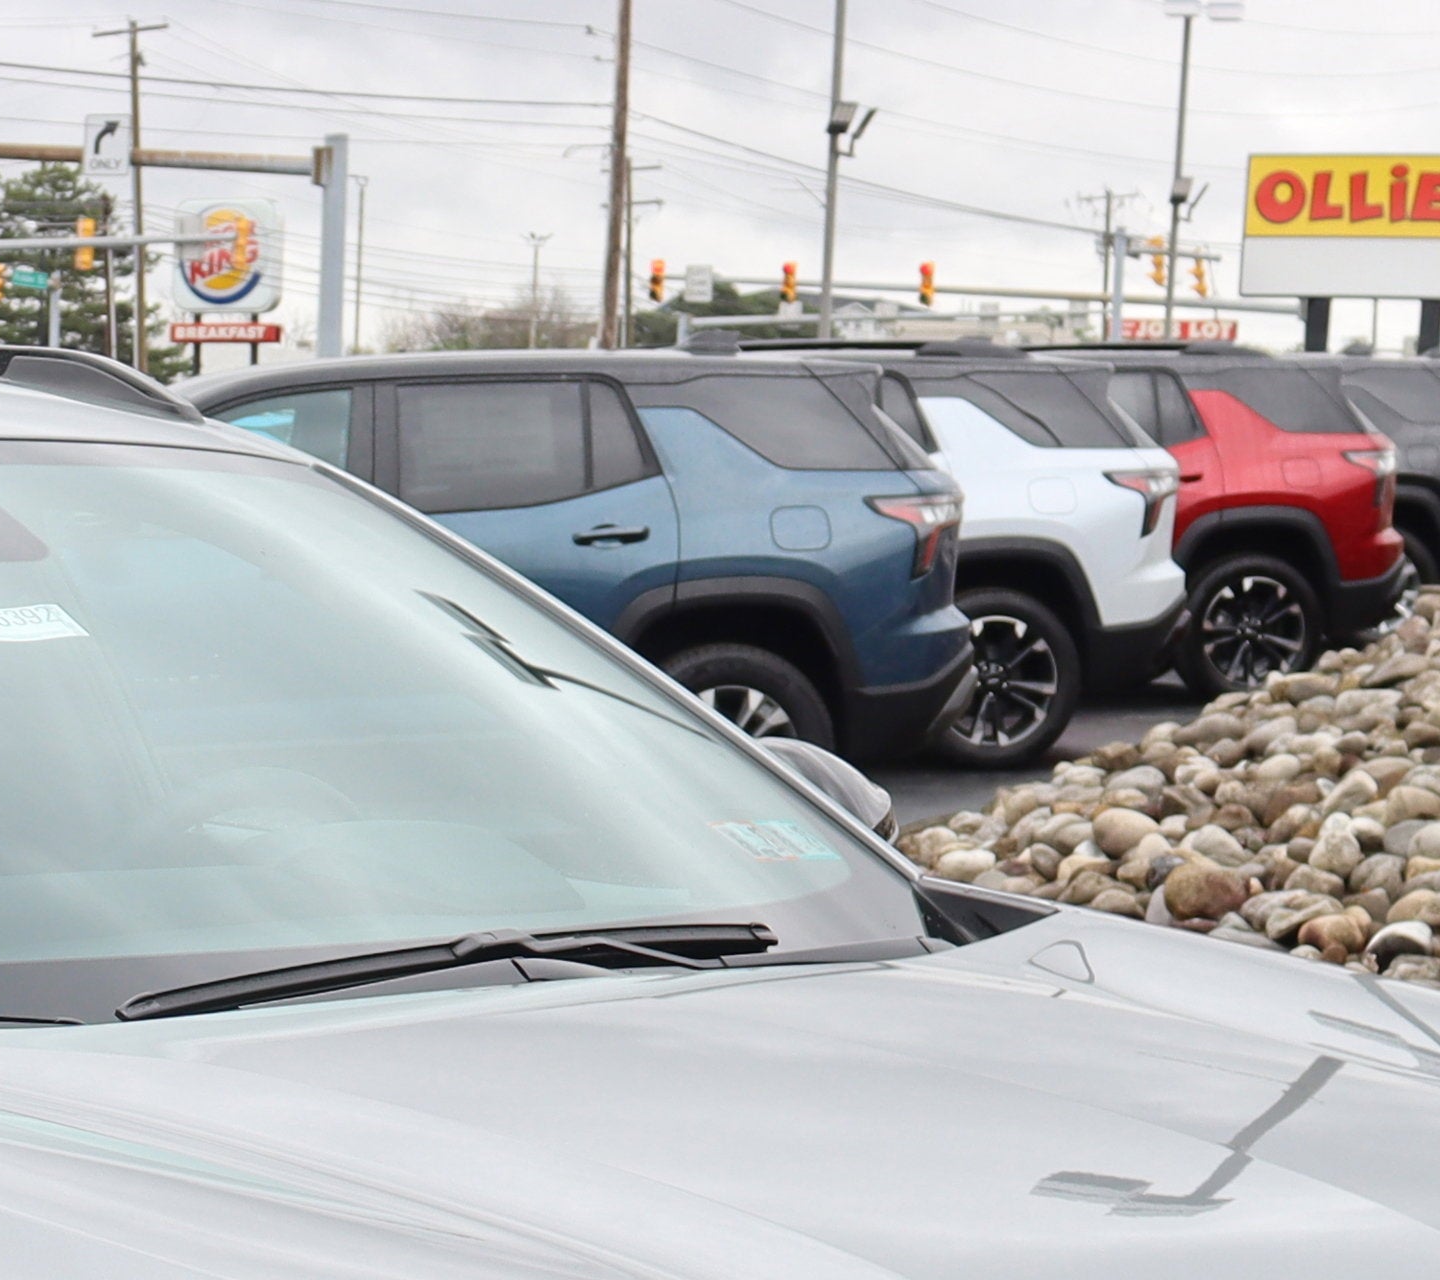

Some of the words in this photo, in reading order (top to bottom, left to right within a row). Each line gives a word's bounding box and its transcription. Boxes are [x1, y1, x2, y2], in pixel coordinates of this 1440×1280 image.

[89, 157, 123, 169] ONLY
[174, 326, 267, 339] BREAKFAST
[1190, 320, 1232, 339] LOT
